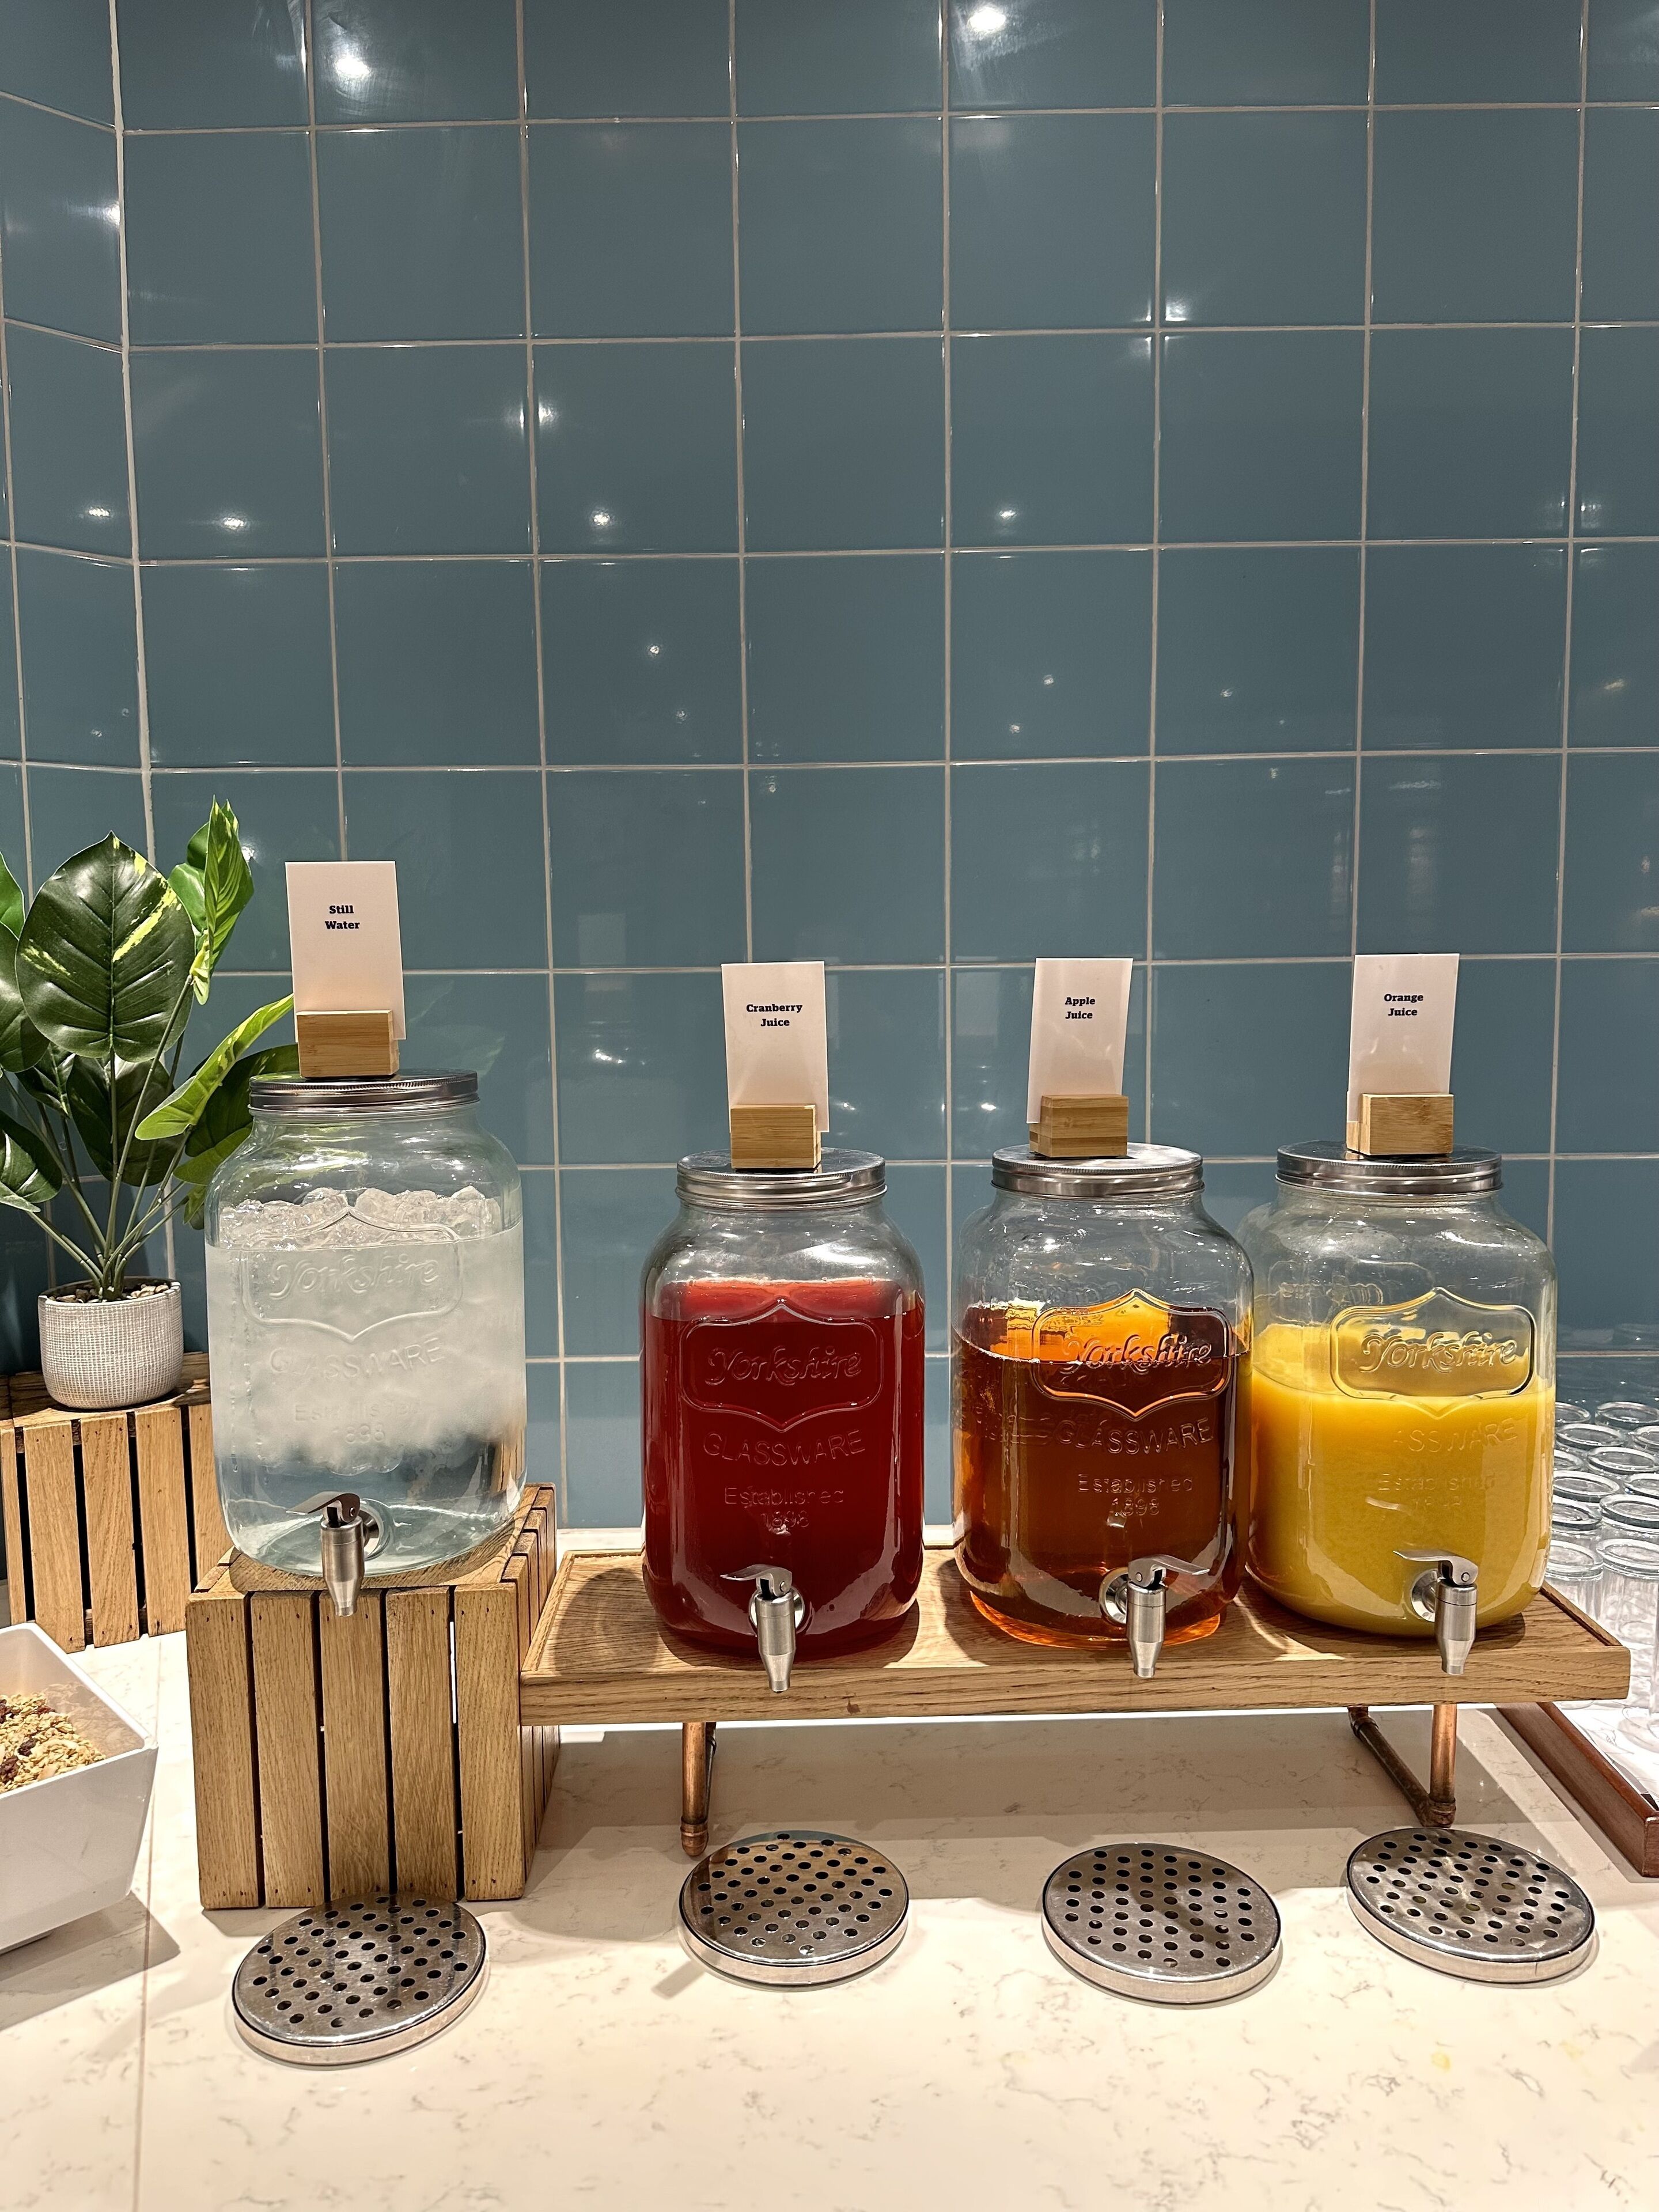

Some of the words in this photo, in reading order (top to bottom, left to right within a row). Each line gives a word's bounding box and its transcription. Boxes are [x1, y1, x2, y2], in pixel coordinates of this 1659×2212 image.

[329, 905, 354, 914] Still
[324, 921, 360, 930] Water
[1065, 997, 1096, 1006] Apple
[1384, 994, 1424, 1003] Orange
[746, 1003, 803, 1013] Cranberry
[1388, 1007, 1418, 1016] Juice
[1065, 1010, 1093, 1019] Juice
[760, 1018, 790, 1027] Juice
[1059, 1332, 1212, 1376] Yorkshire
[1358, 1330, 1518, 1374] Yorkshire
[704, 1344, 862, 1387] Yorkshire
[1054, 1417, 1214, 1456] GLASSWARE
[702, 1429, 866, 1466] GLASSWARE
